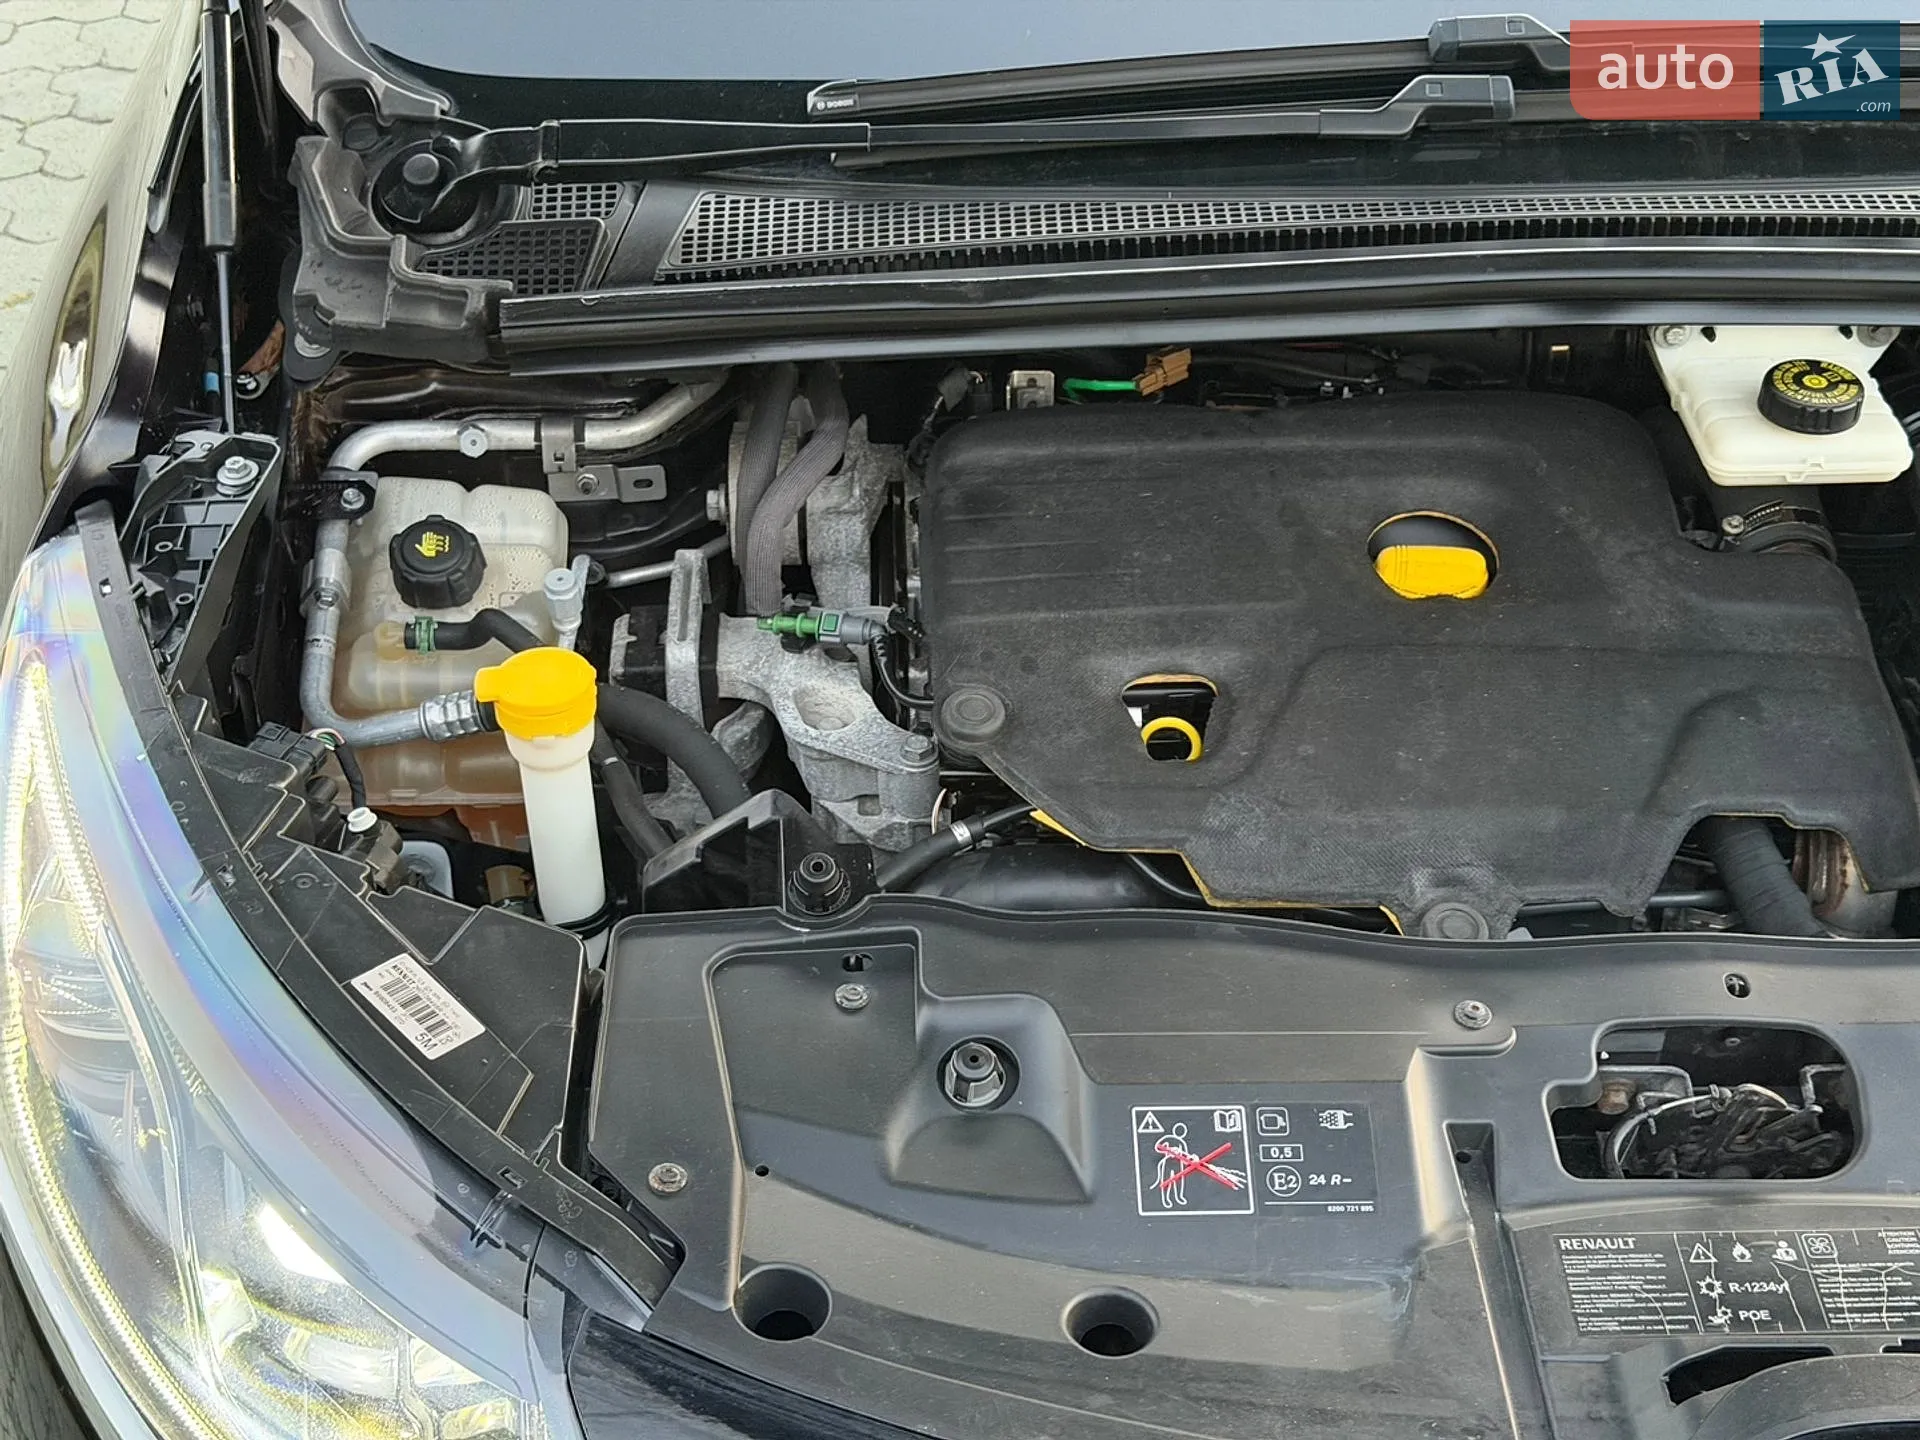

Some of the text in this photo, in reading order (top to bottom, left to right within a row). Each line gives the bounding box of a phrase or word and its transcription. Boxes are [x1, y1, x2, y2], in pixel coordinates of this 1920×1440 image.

[1270, 1147, 1293, 1159] 0,5
[1272, 1172, 1297, 1191] E2
[1308, 1174, 1327, 1185] 24
[1559, 1237, 1636, 1250] RENAULT
[1738, 1309, 1772, 1321] POE
